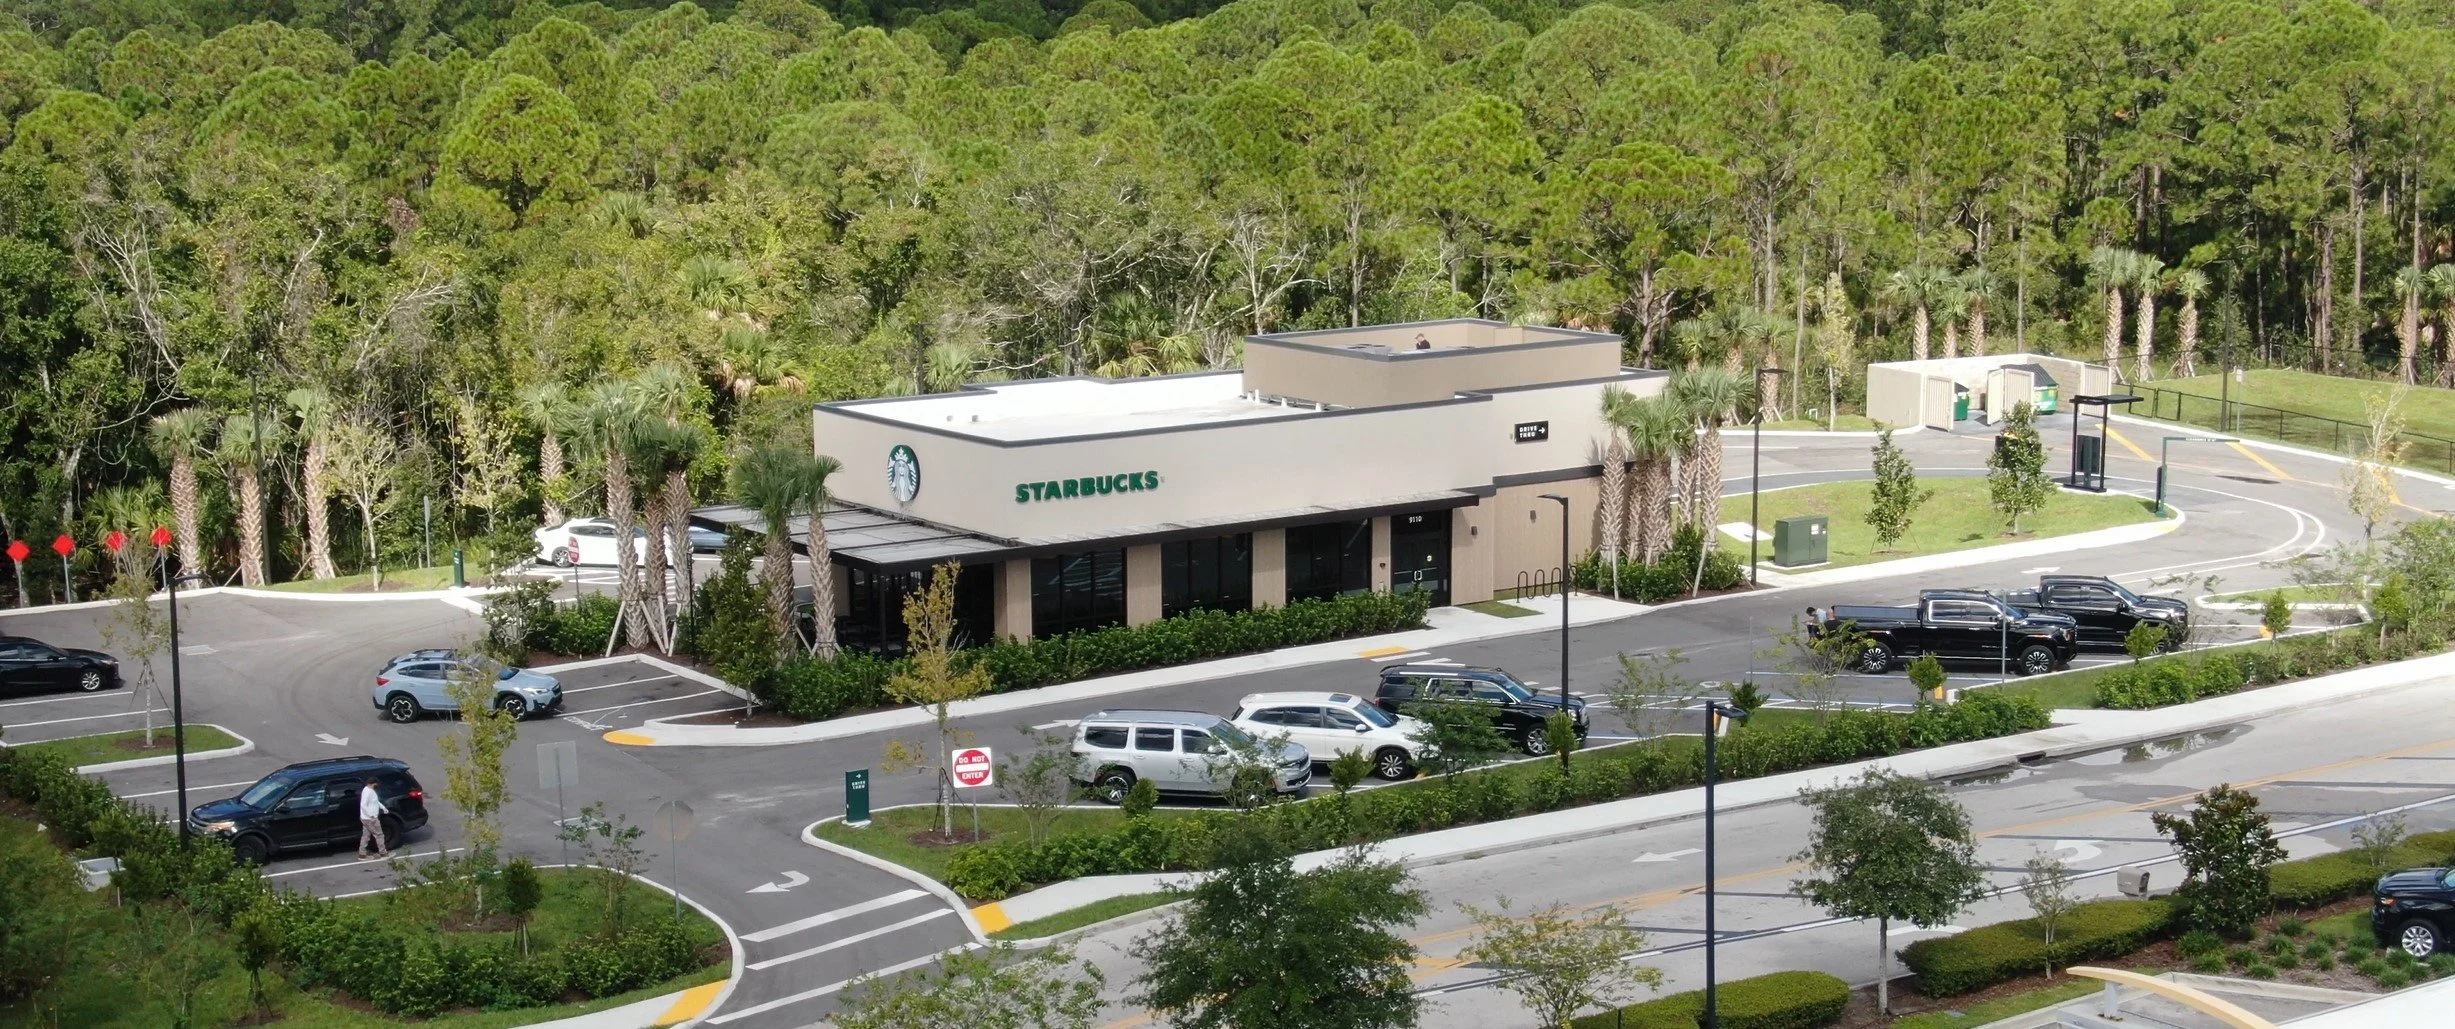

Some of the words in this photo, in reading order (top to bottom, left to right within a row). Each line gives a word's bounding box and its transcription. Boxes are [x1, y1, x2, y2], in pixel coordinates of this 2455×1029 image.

[1015, 470, 1159, 503] STARBUCKS
[958, 756, 969, 764] DO
[971, 755, 985, 763] NOT
[961, 771, 984, 780] ENTER
